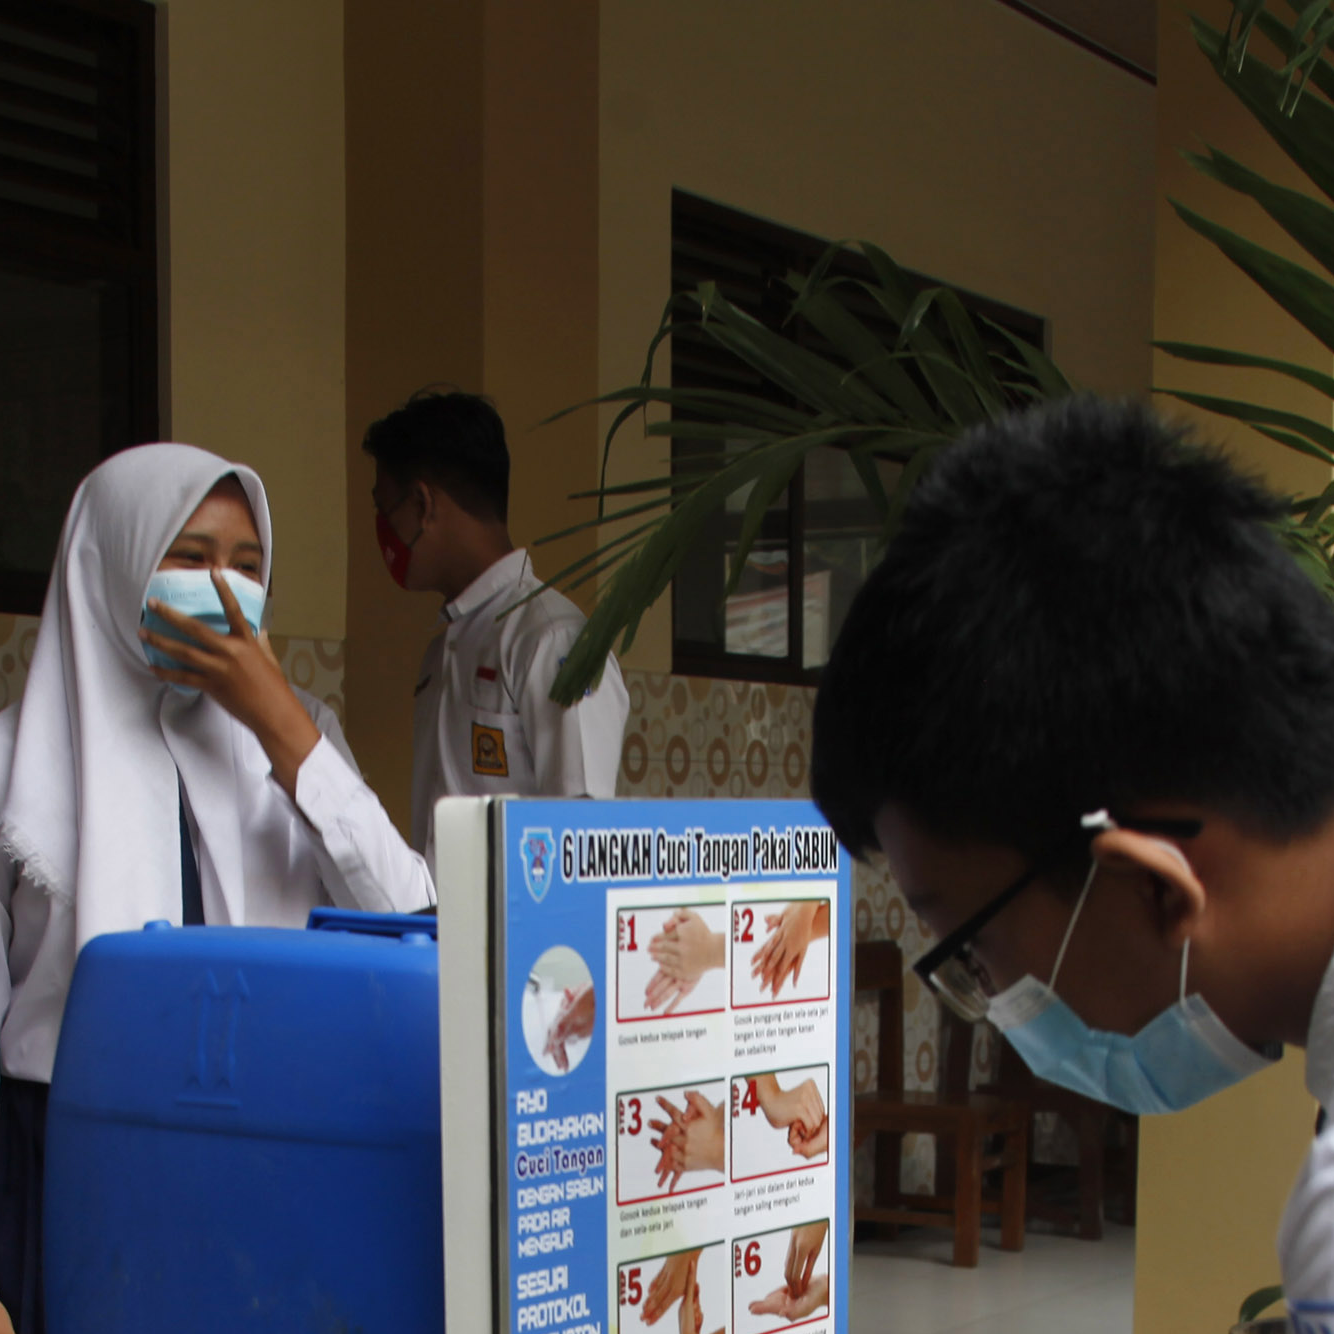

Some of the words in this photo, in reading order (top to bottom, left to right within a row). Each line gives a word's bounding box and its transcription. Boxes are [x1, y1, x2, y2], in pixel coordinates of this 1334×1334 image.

[563, 833, 573, 878] 6
[578, 833, 651, 878] LANGKAH
[656, 832, 690, 876] Cuci
[694, 832, 749, 878] Tangan
[752, 830, 791, 871] Pakai
[793, 829, 838, 871] SABUN
[627, 914, 638, 951] 1
[741, 908, 754, 942] 2
[741, 1079, 761, 1116] 4
[517, 1112, 604, 1148] BUDAYAKAN
[628, 1097, 642, 1136] 3
[516, 1148, 550, 1177] Cuci
[553, 1146, 604, 1174] Tangan
[517, 1182, 565, 1210] DENGAN
[566, 1176, 604, 1200] SABUN
[744, 1240, 761, 1277] 6
[628, 1267, 642, 1306] 5
[517, 1292, 591, 1333] PROTOKOL
